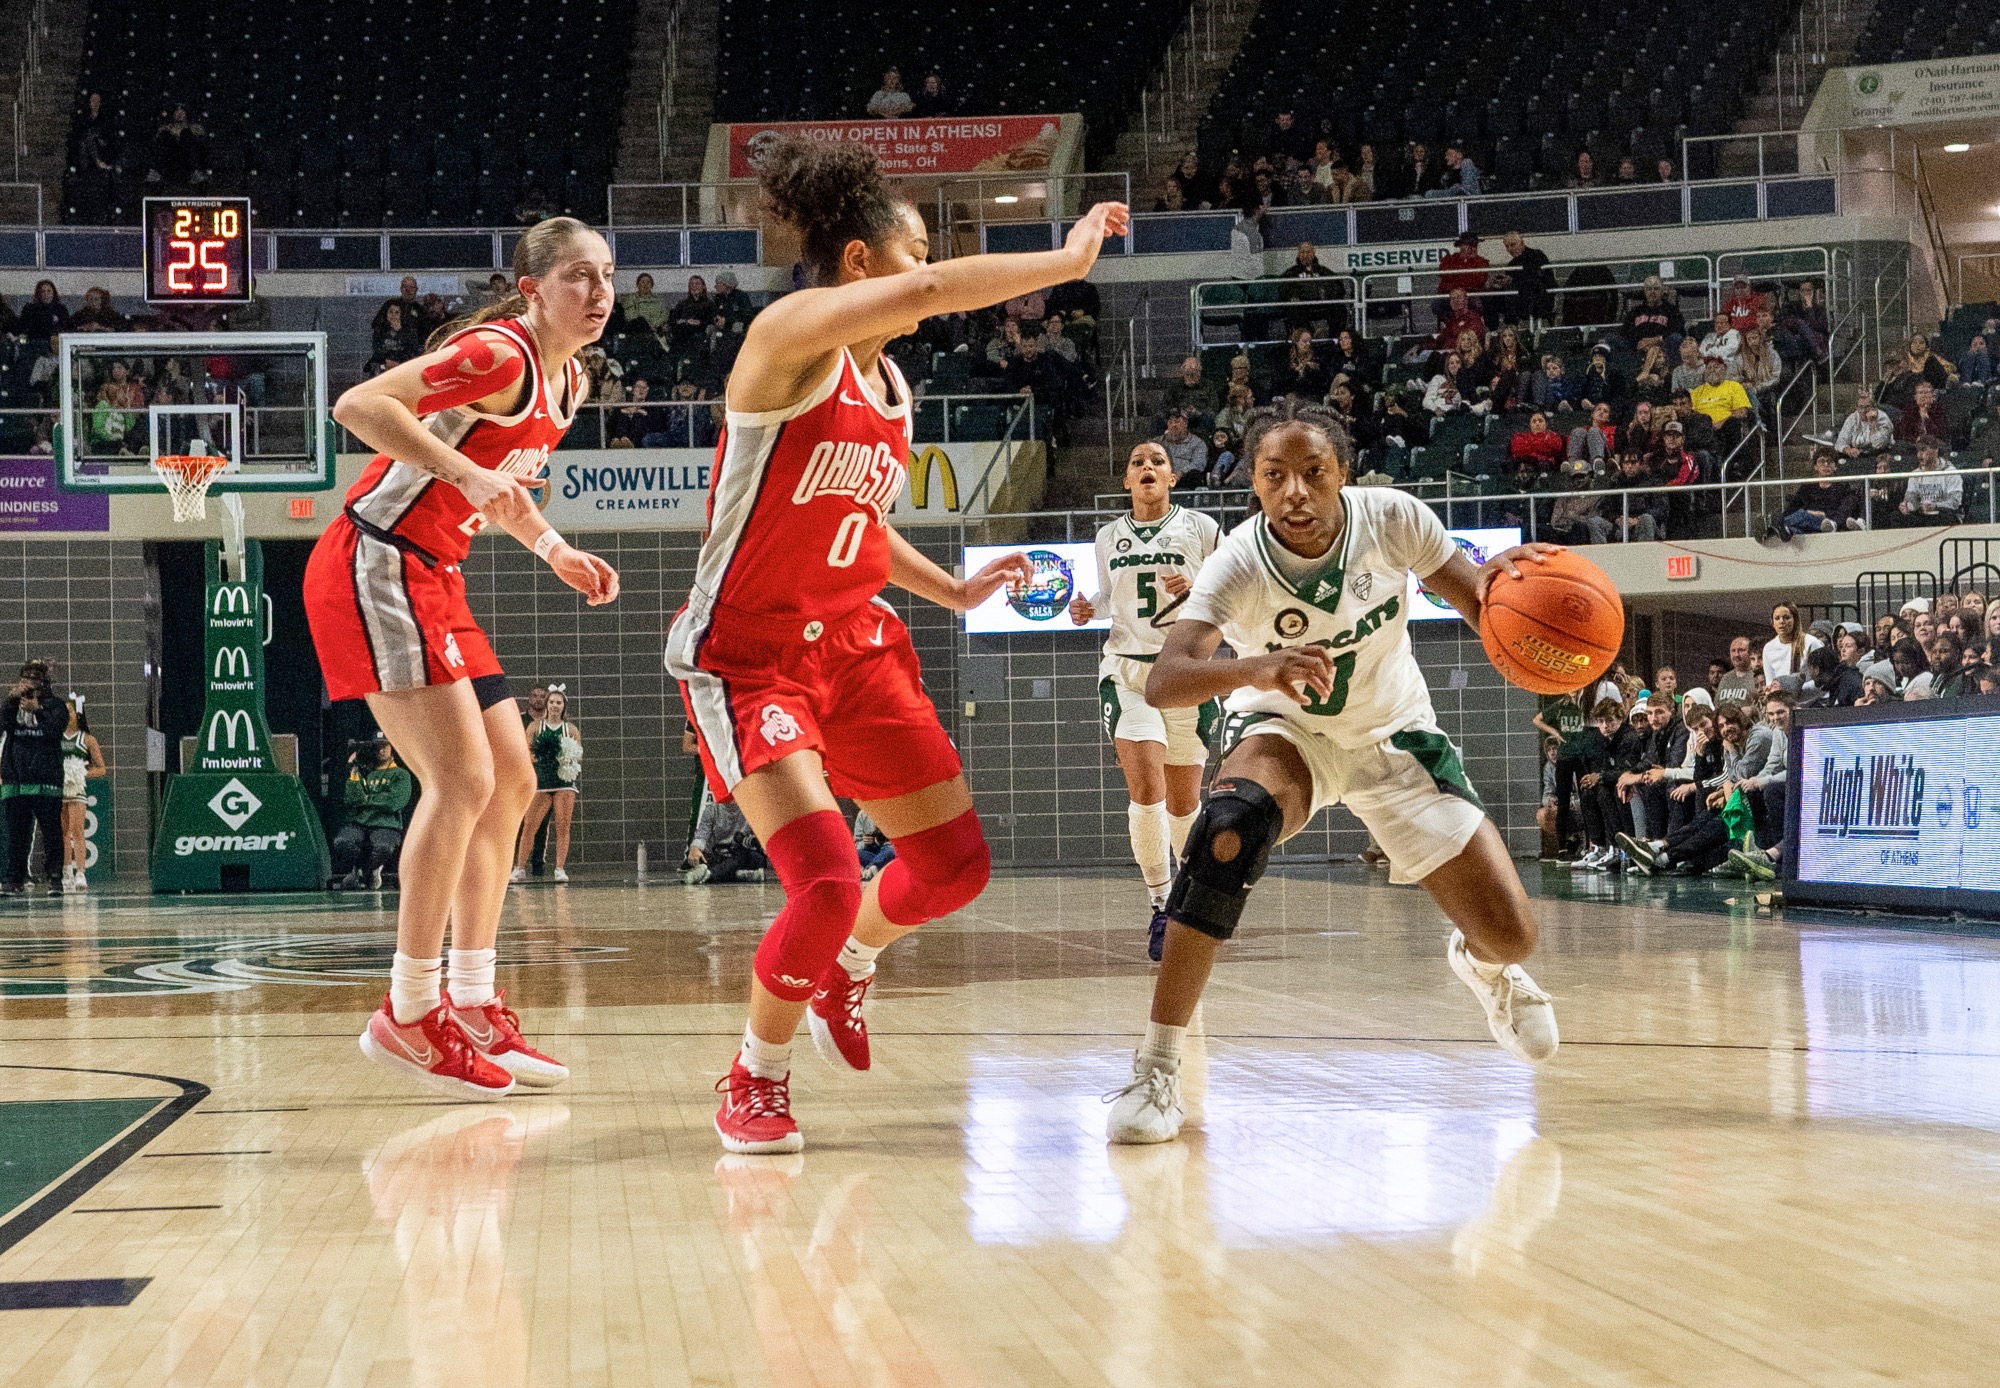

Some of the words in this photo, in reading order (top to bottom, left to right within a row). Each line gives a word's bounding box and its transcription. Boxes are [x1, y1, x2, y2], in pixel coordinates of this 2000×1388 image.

[1929, 79, 1984, 92] Insurance
[800, 128, 843, 141] NOW
[848, 127, 898, 140] OPEN
[903, 127, 920, 140] IN
[925, 123, 1002, 139] ATHENS!
[895, 143, 927, 154] State
[931, 142, 948, 153] St.
[917, 156, 936, 167] OH
[175, 210, 237, 238] 2:10
[168, 240, 228, 291] 25
[563, 464, 711, 499] SNOWVILLE
[291, 499, 312, 517] EXIT
[596, 498, 680, 510] CREAMERY
[827, 512, 869, 568] 0
[1110, 552, 1186, 571] BOBCATS
[1667, 555, 1692, 577] EXIT
[1137, 571, 1157, 618] 5
[1029, 606, 1053, 617] SALSA
[246, 618, 254, 627] it
[247, 681, 254, 690] it
[1719, 687, 1747, 701] OHIO
[202, 757, 220, 769] i'm
[220, 757, 252, 769] lovin'
[252, 757, 262, 769] it
[1818, 756, 1864, 837] Hugh
[1867, 755, 1925, 826] White
[174, 831, 289, 856] gomart
[1880, 850, 1890, 864] OF
[1890, 850, 1919, 866] ATHENS
